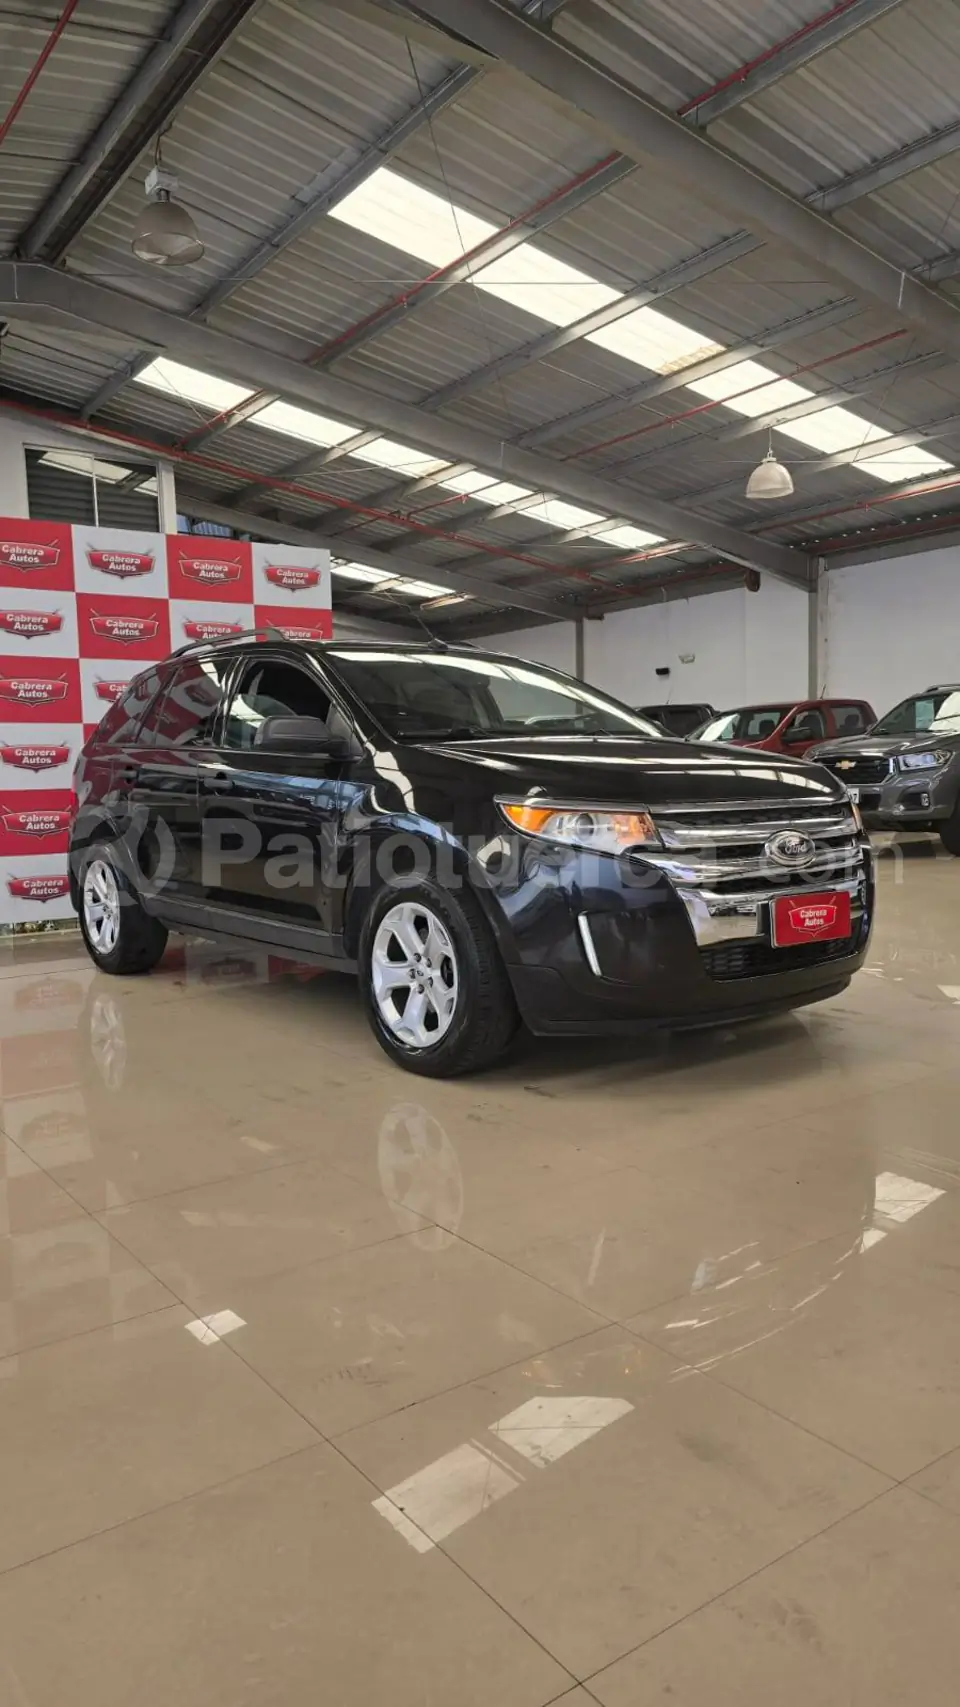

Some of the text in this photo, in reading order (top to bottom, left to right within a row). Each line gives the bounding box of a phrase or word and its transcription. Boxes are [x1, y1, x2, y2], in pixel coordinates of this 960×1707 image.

[2, 544, 44, 556] Cabrera
[9, 555, 39, 563] Autos
[102, 554, 141, 564] Cabrera
[108, 562, 137, 571] Autos
[193, 562, 229, 572] Cabrera
[199, 570, 225, 578] Autos
[276, 569, 309, 578] Cabrera
[282, 577, 306, 585] Autos
[6, 613, 48, 624] Cabrera
[13, 622, 44, 631] Autos
[106, 619, 144, 629] Cabrera
[112, 627, 140, 636] Autos
[195, 624, 231, 634] Cabrera
[11, 682, 52, 690] Cabrera
[18, 690, 48, 698] Autos
[15, 748, 56, 757] Cabrera
[22, 756, 52, 764] Autos
[19, 814, 60, 823] Cabrera
[26, 822, 55, 830] Autos
[23, 880, 64, 888] Cabrera
[30, 887, 60, 895] Autos
